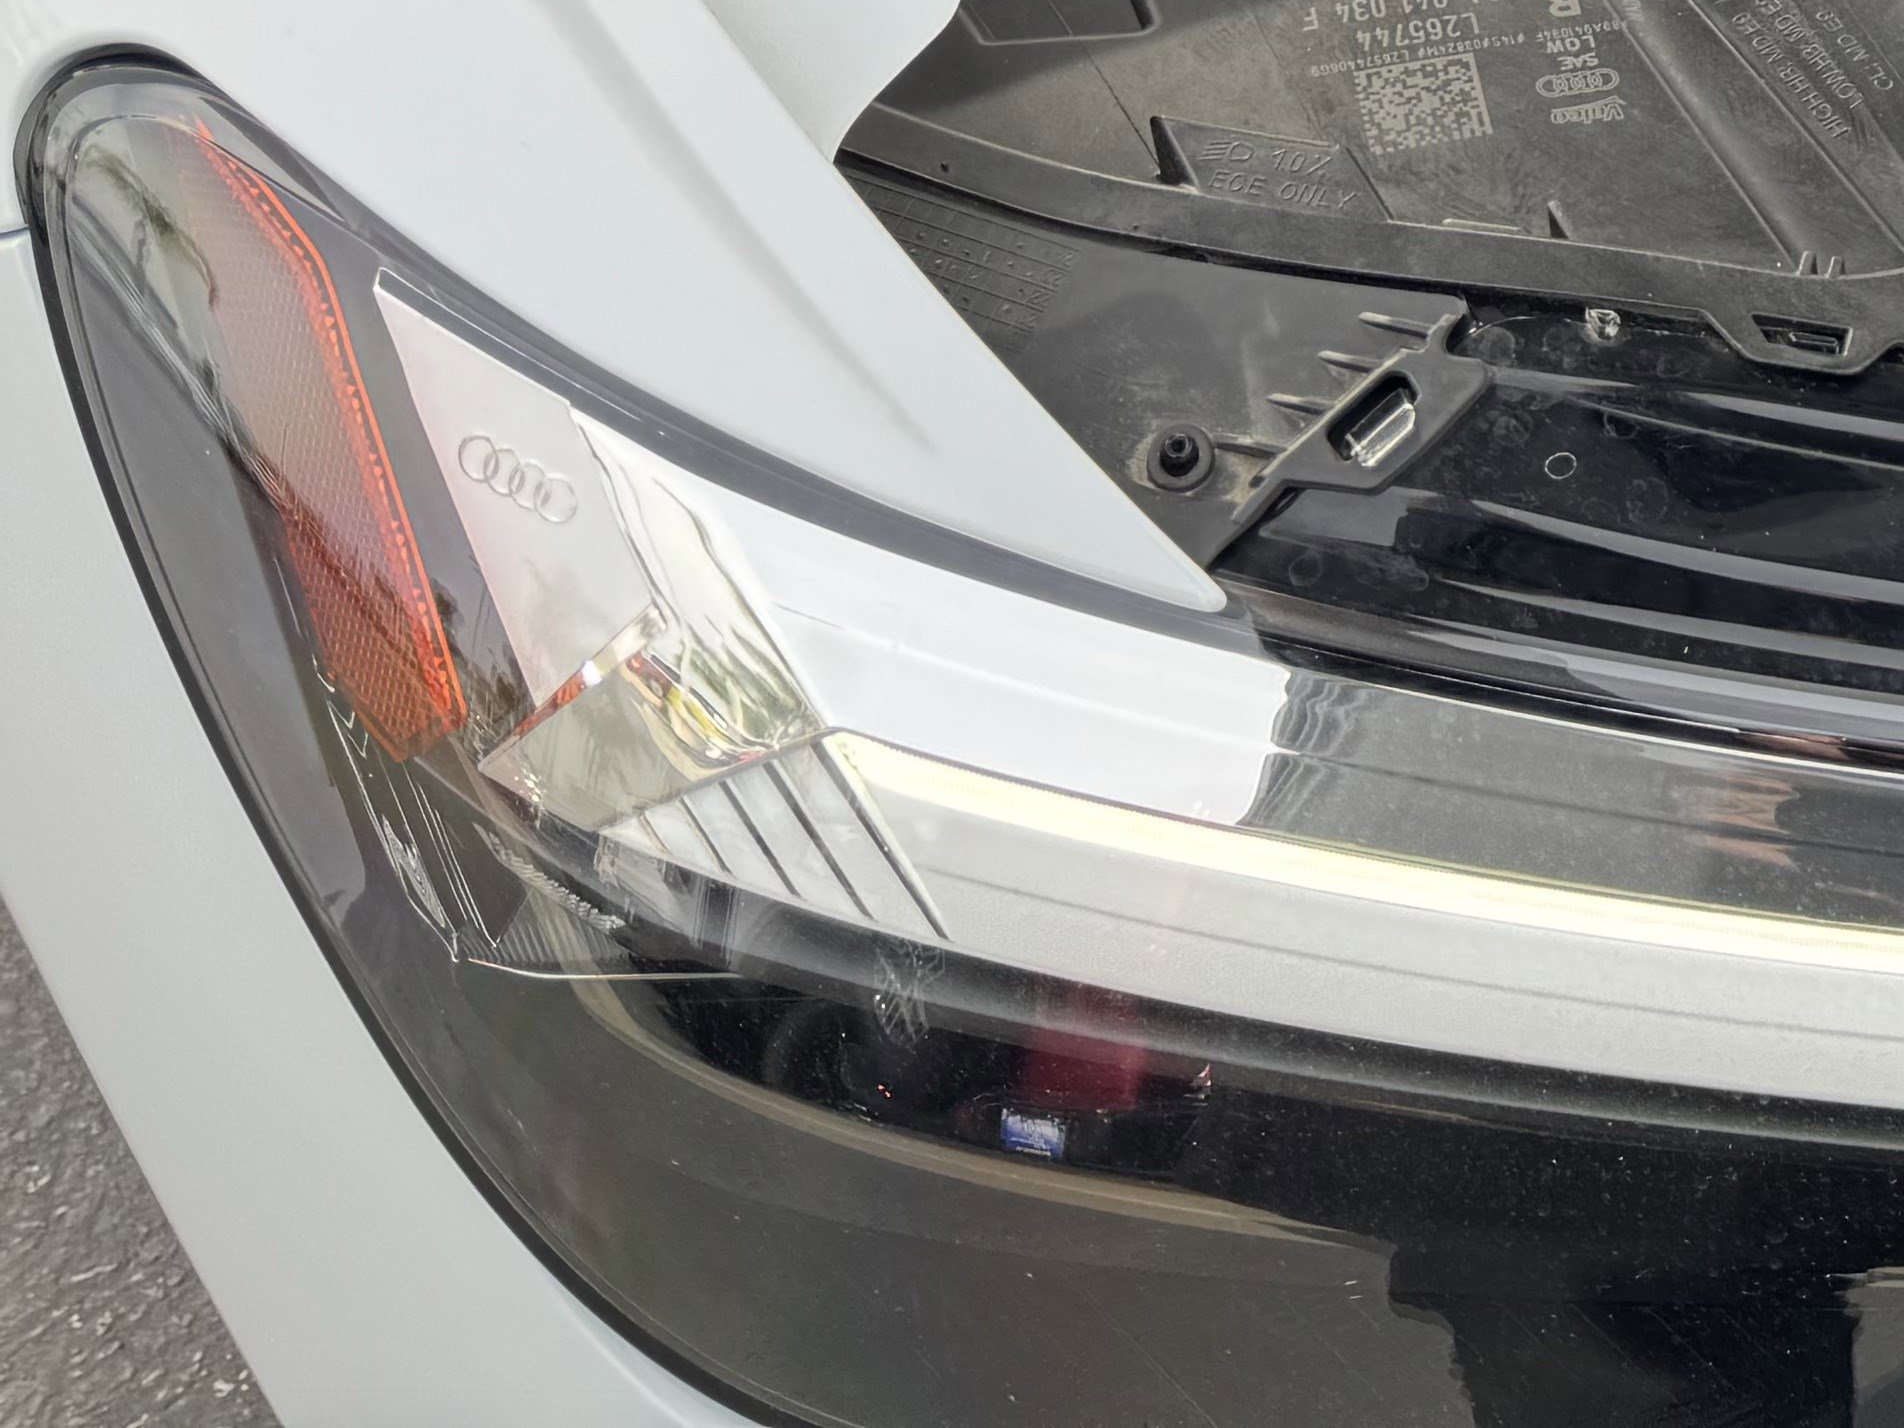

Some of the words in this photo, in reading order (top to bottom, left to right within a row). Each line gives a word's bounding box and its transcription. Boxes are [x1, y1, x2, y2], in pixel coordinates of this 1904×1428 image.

[1299, 5, 1319, 31] F
[1354, 10, 1478, 48] L265744
[1544, 34, 1595, 54] LOW
[1556, 51, 1598, 70] SAE
[1277, 177, 1363, 213] ONLY
